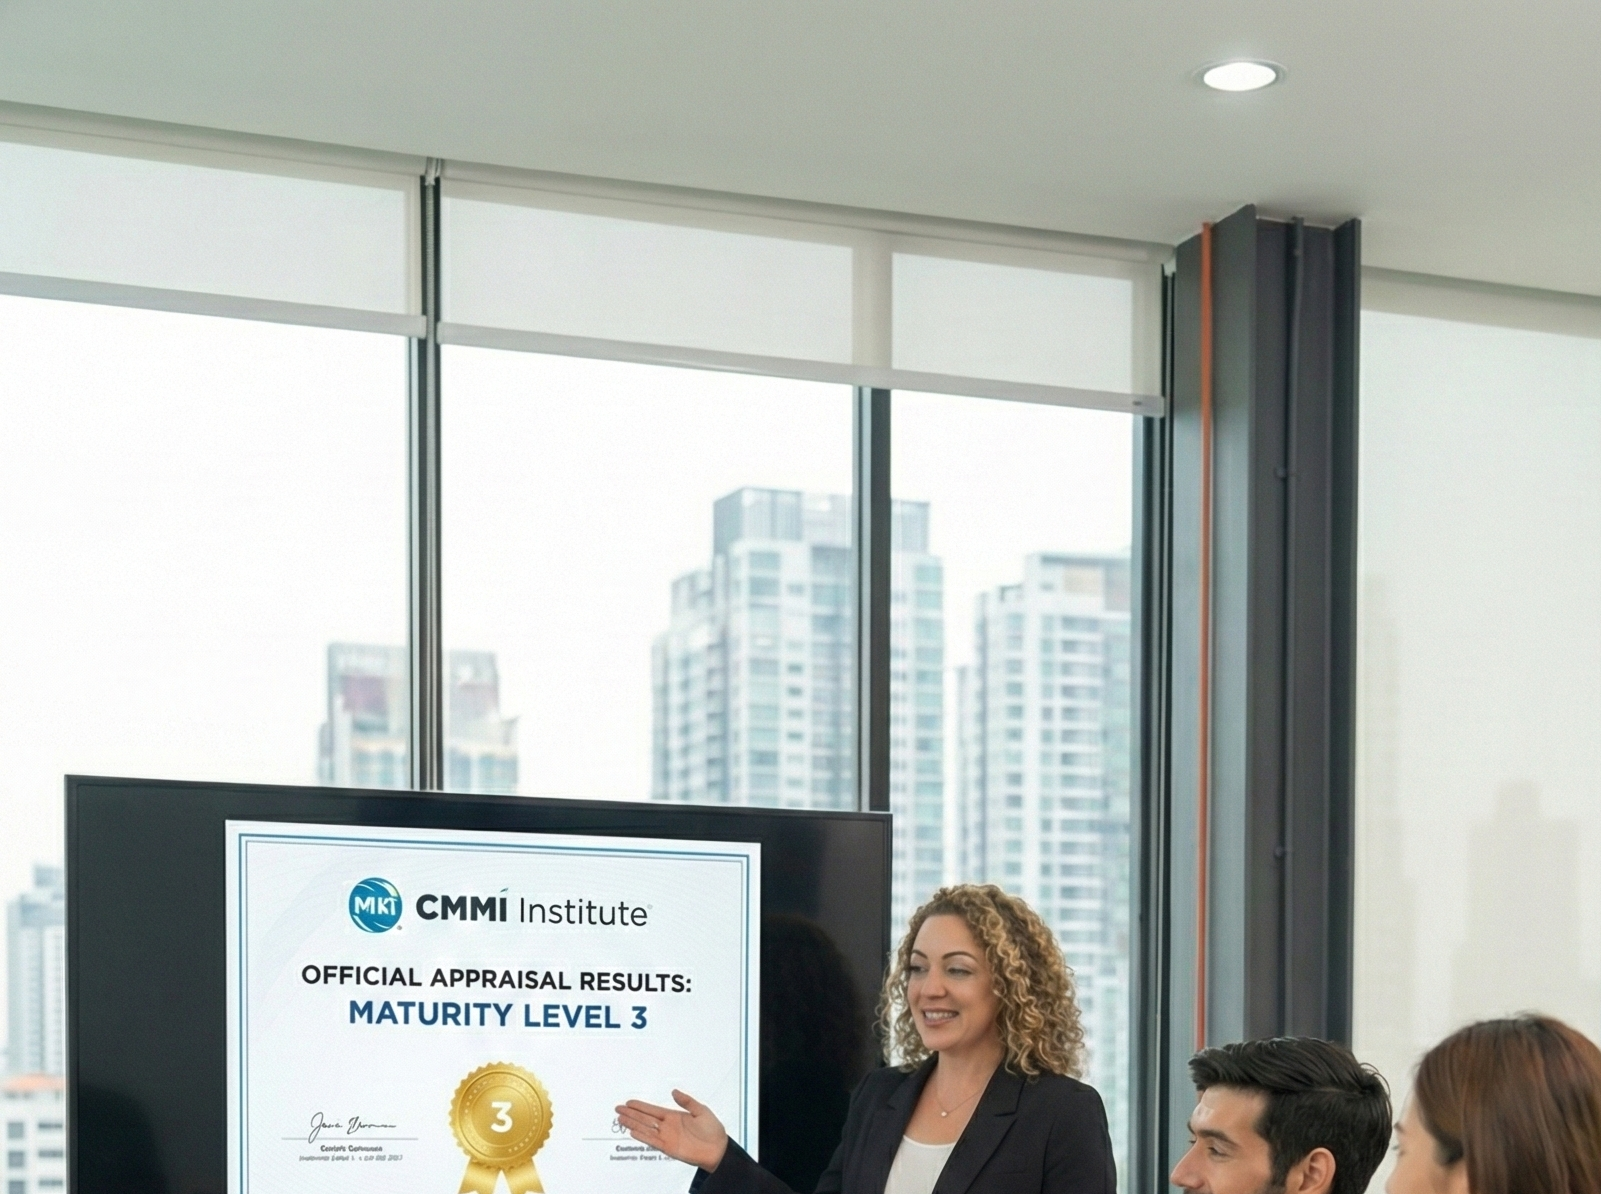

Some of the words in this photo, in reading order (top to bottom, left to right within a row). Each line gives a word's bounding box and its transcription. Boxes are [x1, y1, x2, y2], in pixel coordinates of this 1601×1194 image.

[520, 897, 648, 926] Institute
[301, 964, 422, 986] OFFICIAL
[430, 968, 572, 990] APPRAISAL
[580, 972, 692, 993] RESULTS:
[349, 1000, 514, 1027] MATURITY
[524, 1004, 621, 1029] LEVEL
[630, 1006, 648, 1030] 3
[490, 1101, 513, 1133] 3
